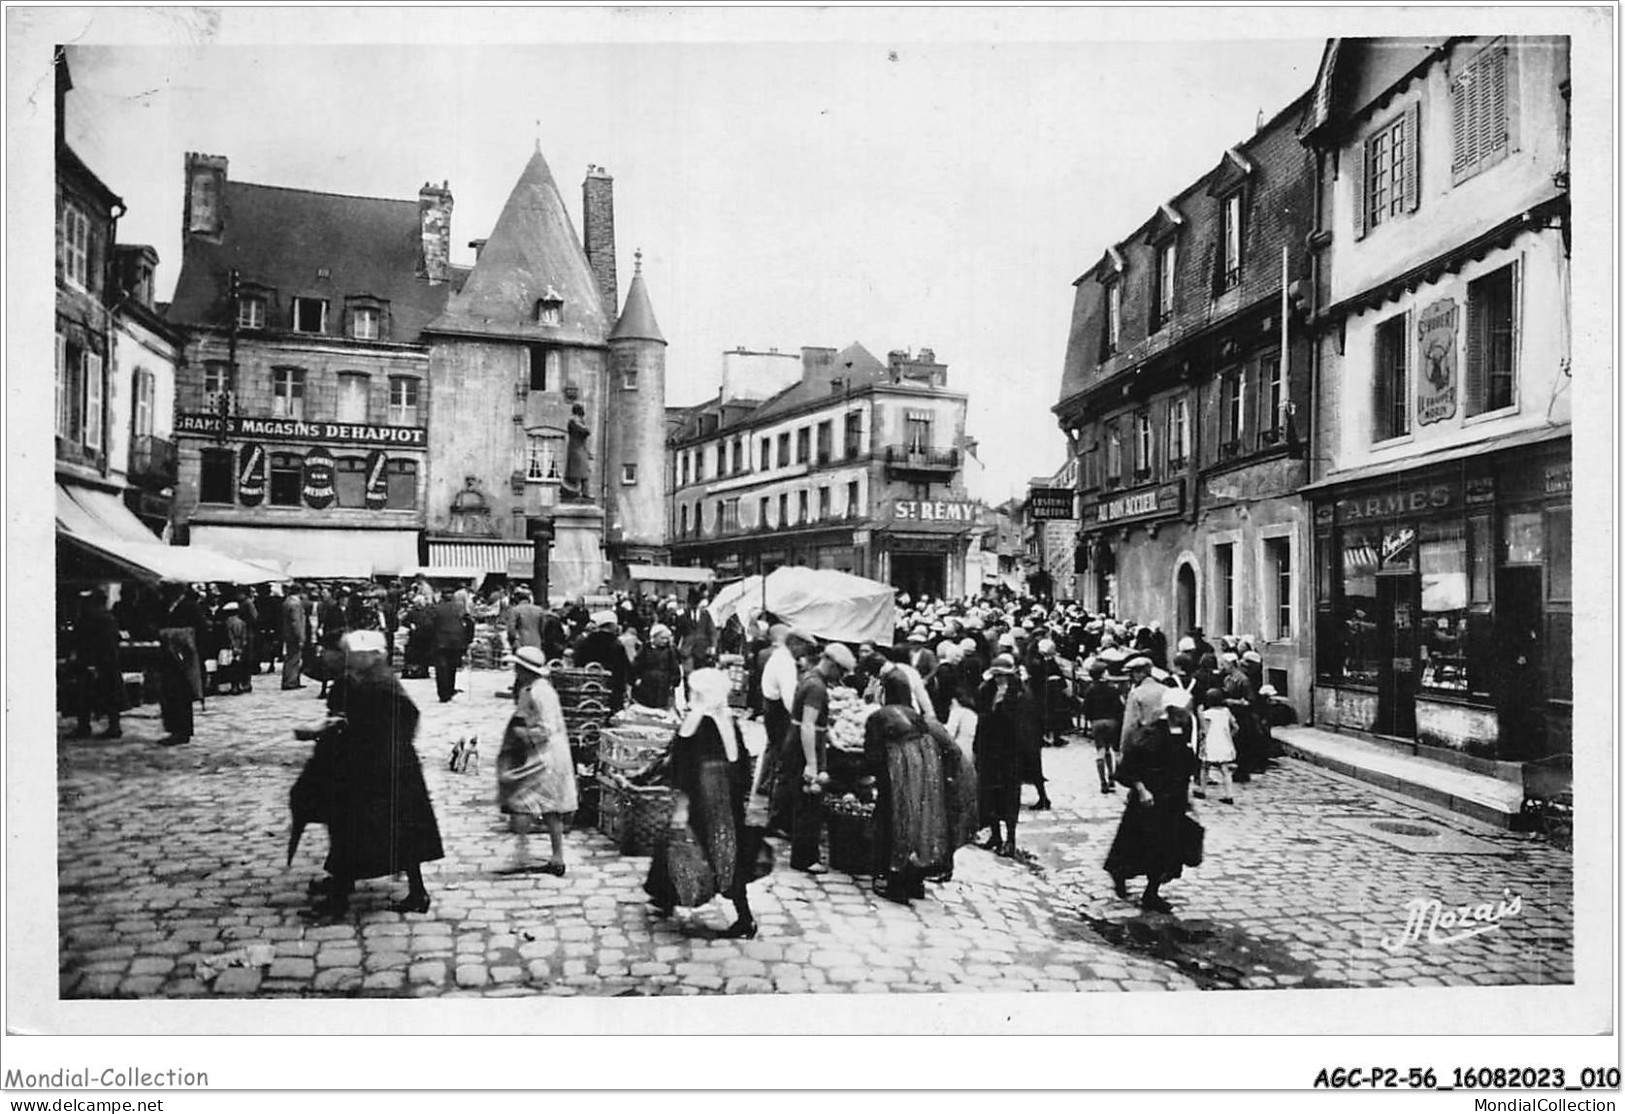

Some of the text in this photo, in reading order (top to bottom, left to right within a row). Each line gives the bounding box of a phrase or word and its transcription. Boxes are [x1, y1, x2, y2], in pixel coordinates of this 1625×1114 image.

[241, 420, 320, 437] MAGASINS
[326, 425, 424, 442] DEHAPIOT
[1097, 503, 1108, 522] AU
[1109, 499, 1124, 520] BON
[1125, 491, 1158, 516] ACCUEIL
[1347, 487, 1449, 518] ARMES
